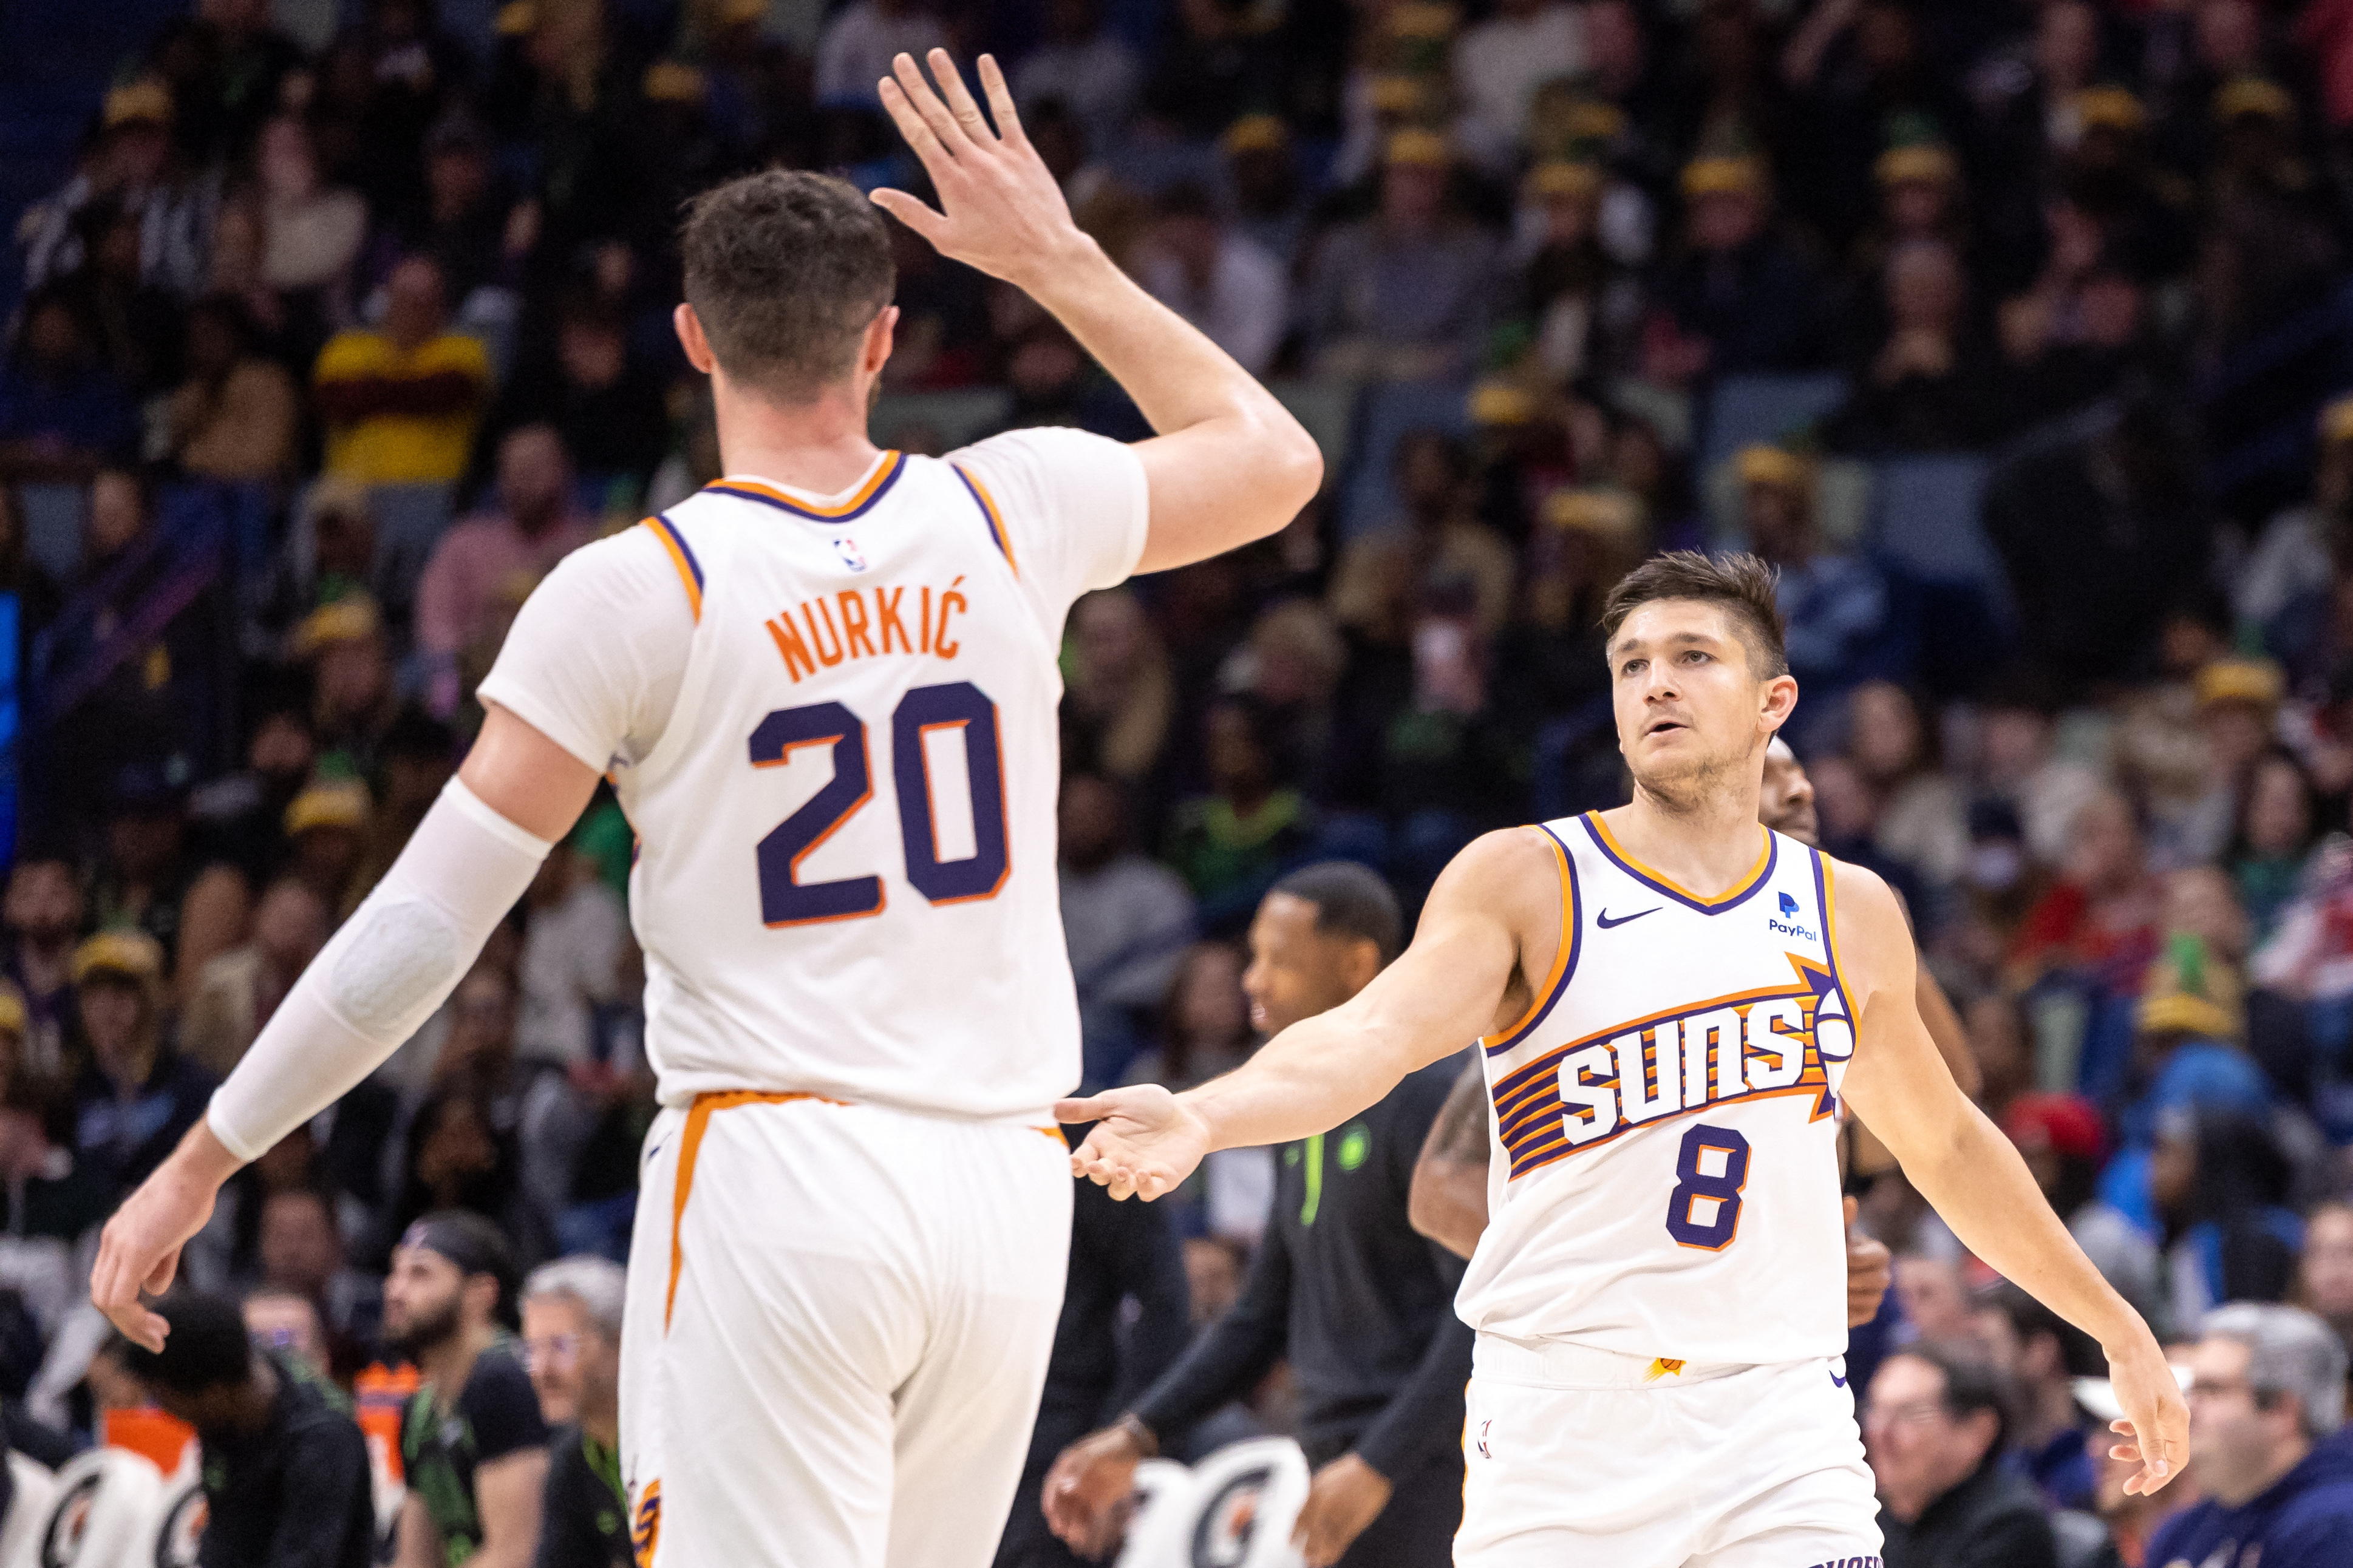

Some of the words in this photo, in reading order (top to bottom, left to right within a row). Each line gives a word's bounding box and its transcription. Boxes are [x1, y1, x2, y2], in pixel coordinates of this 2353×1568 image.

[764, 575, 968, 683] NURKIĆ
[747, 680, 1012, 929] 20
[1769, 918, 1817, 942] PayPal
[1557, 997, 1805, 1145] SUNS
[1666, 1123, 1752, 1252] 8
